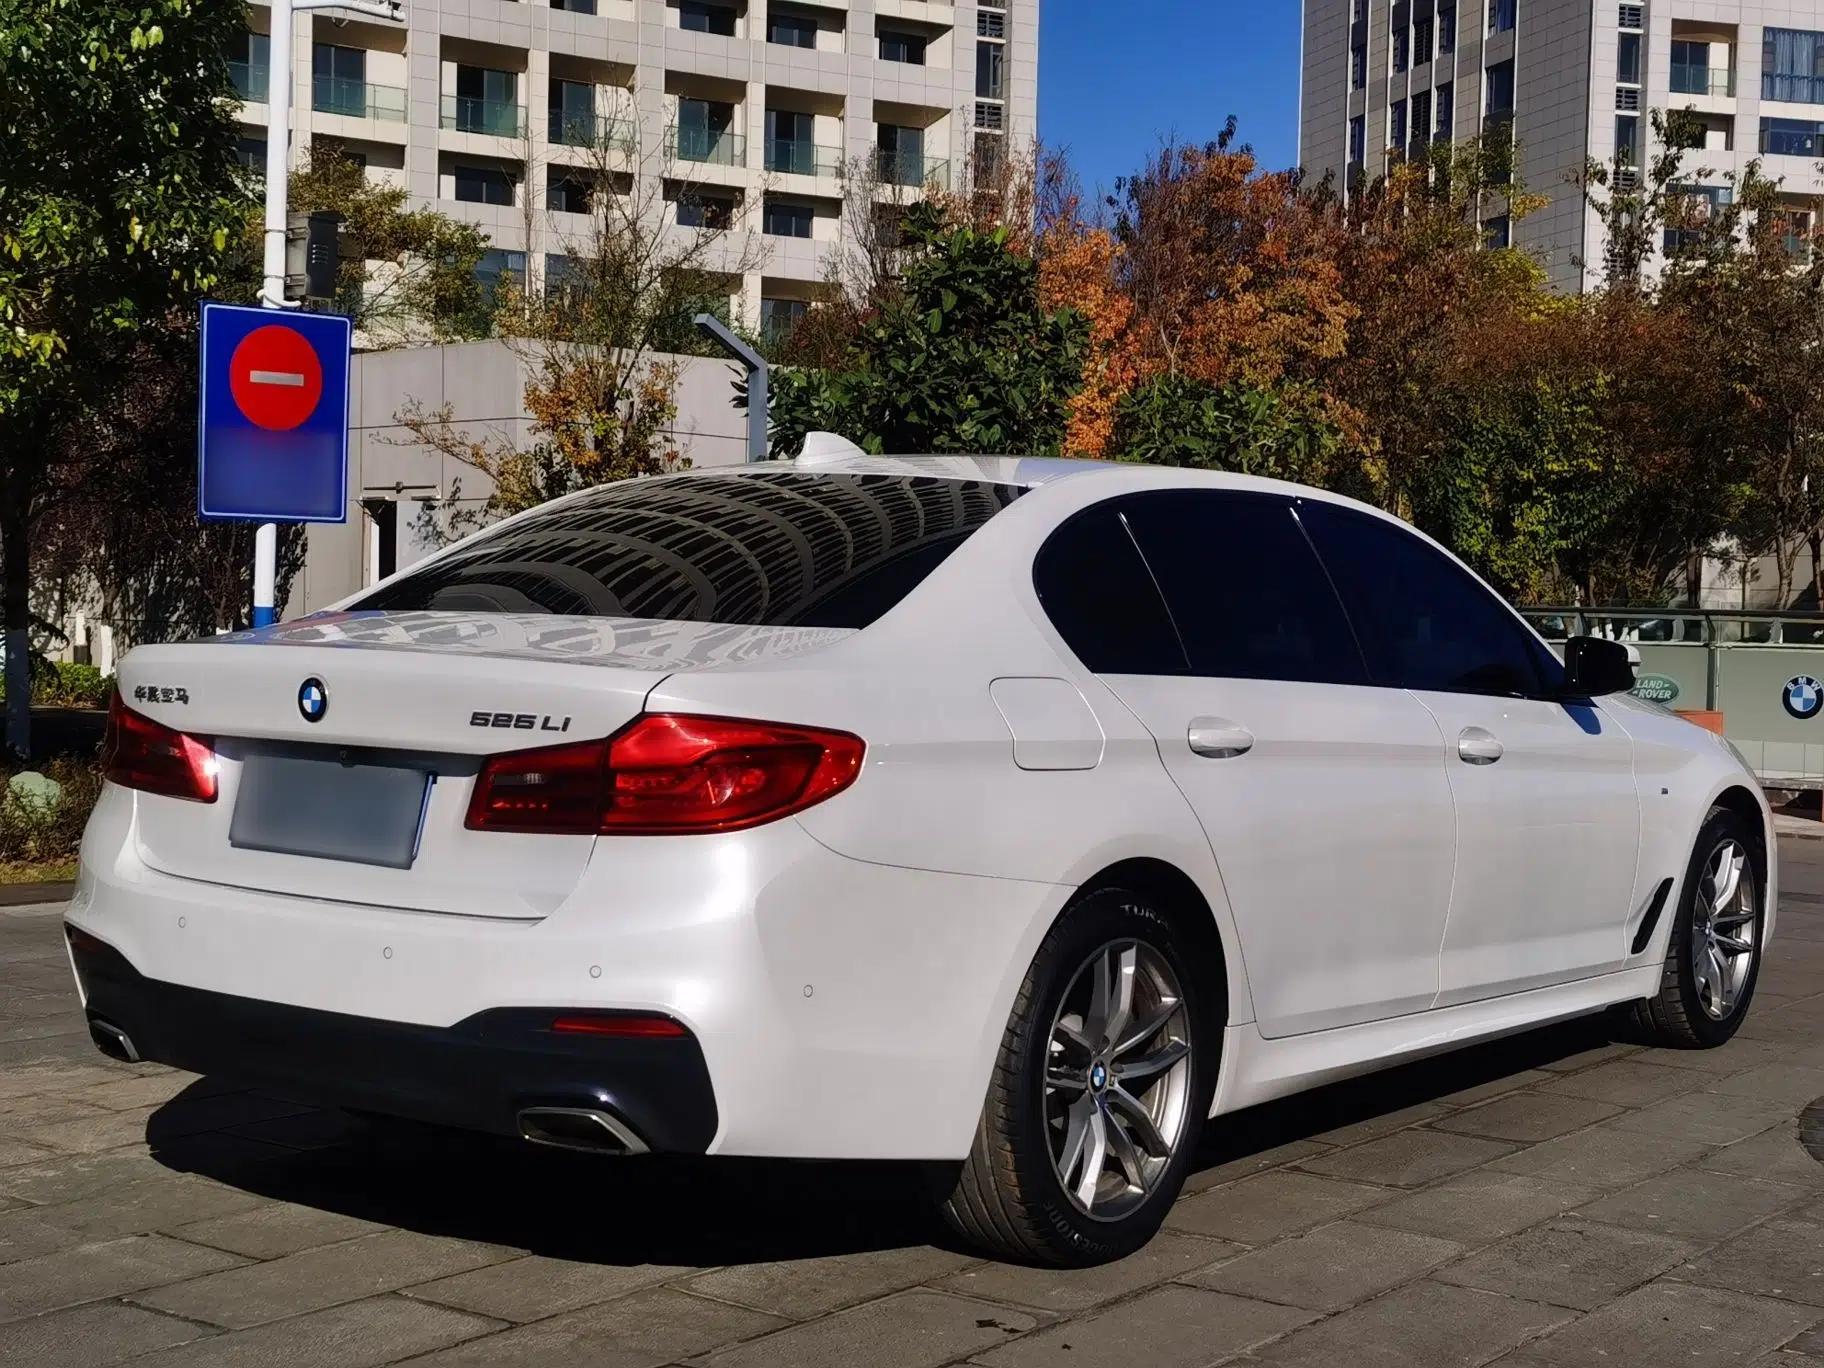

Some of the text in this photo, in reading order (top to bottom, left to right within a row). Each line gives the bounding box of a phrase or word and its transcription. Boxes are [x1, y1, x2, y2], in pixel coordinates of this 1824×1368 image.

[1636, 679, 1664, 689] LAND
[1786, 676, 1821, 691] BMW
[1638, 689, 1672, 699] ROVER
[469, 711, 537, 730] 525
